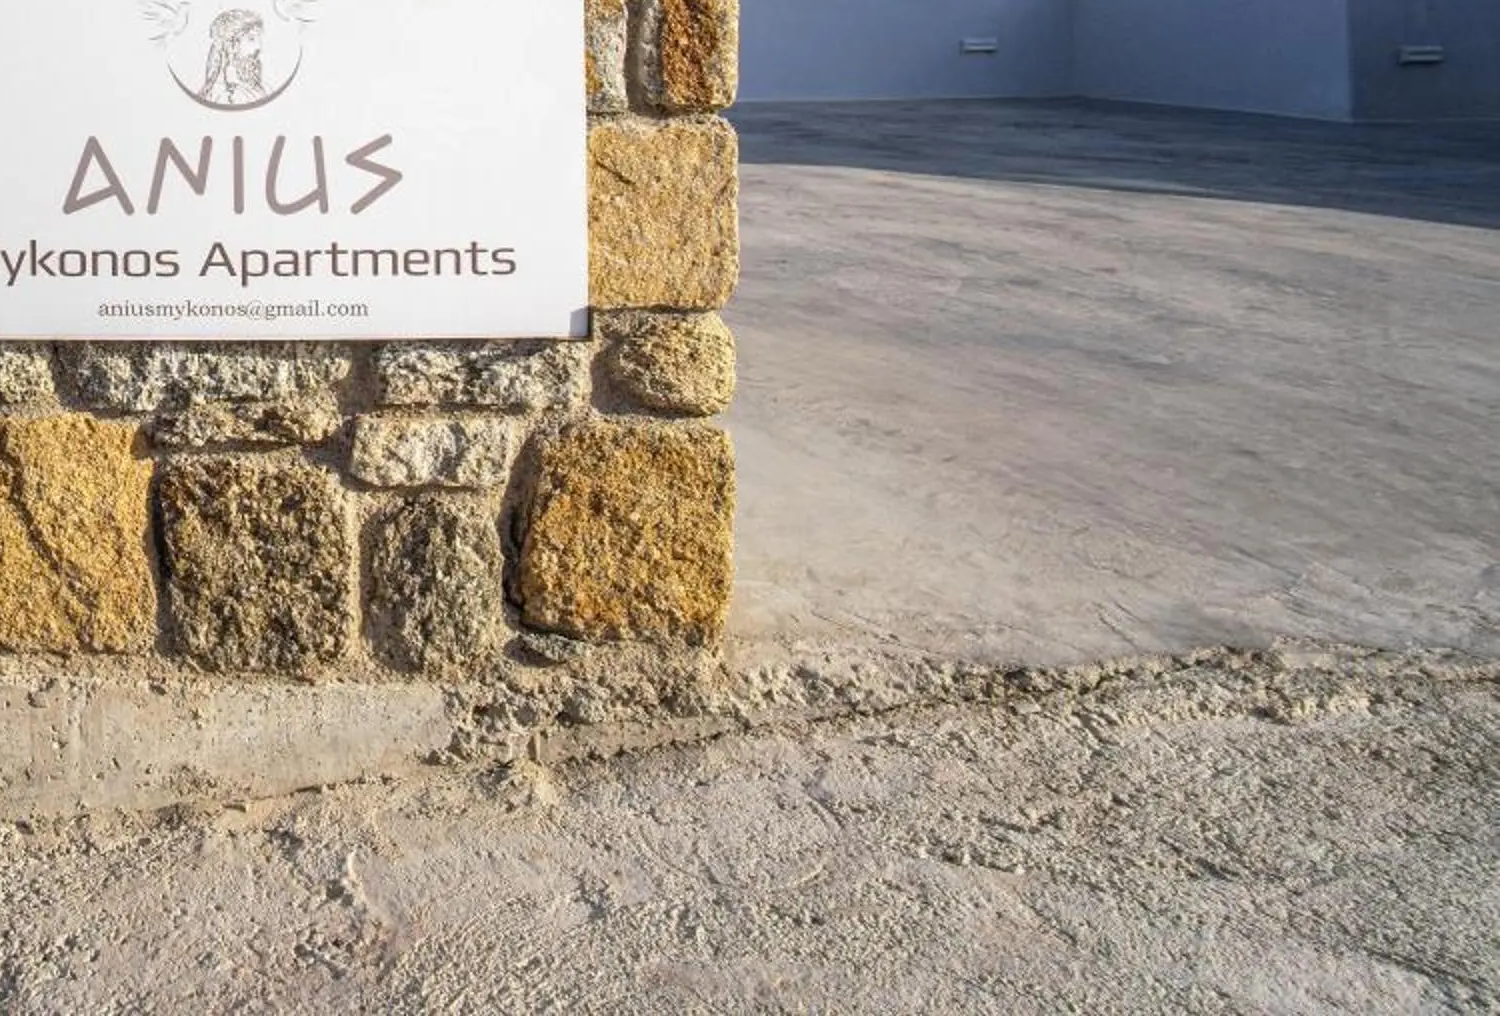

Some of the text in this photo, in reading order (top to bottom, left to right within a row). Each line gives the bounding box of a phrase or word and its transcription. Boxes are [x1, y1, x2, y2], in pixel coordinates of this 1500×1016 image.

[62, 134, 403, 216] ANIUS
[198, 240, 517, 287] Apartments
[98, 298, 369, 321] aniusmykonos@gmail.com
